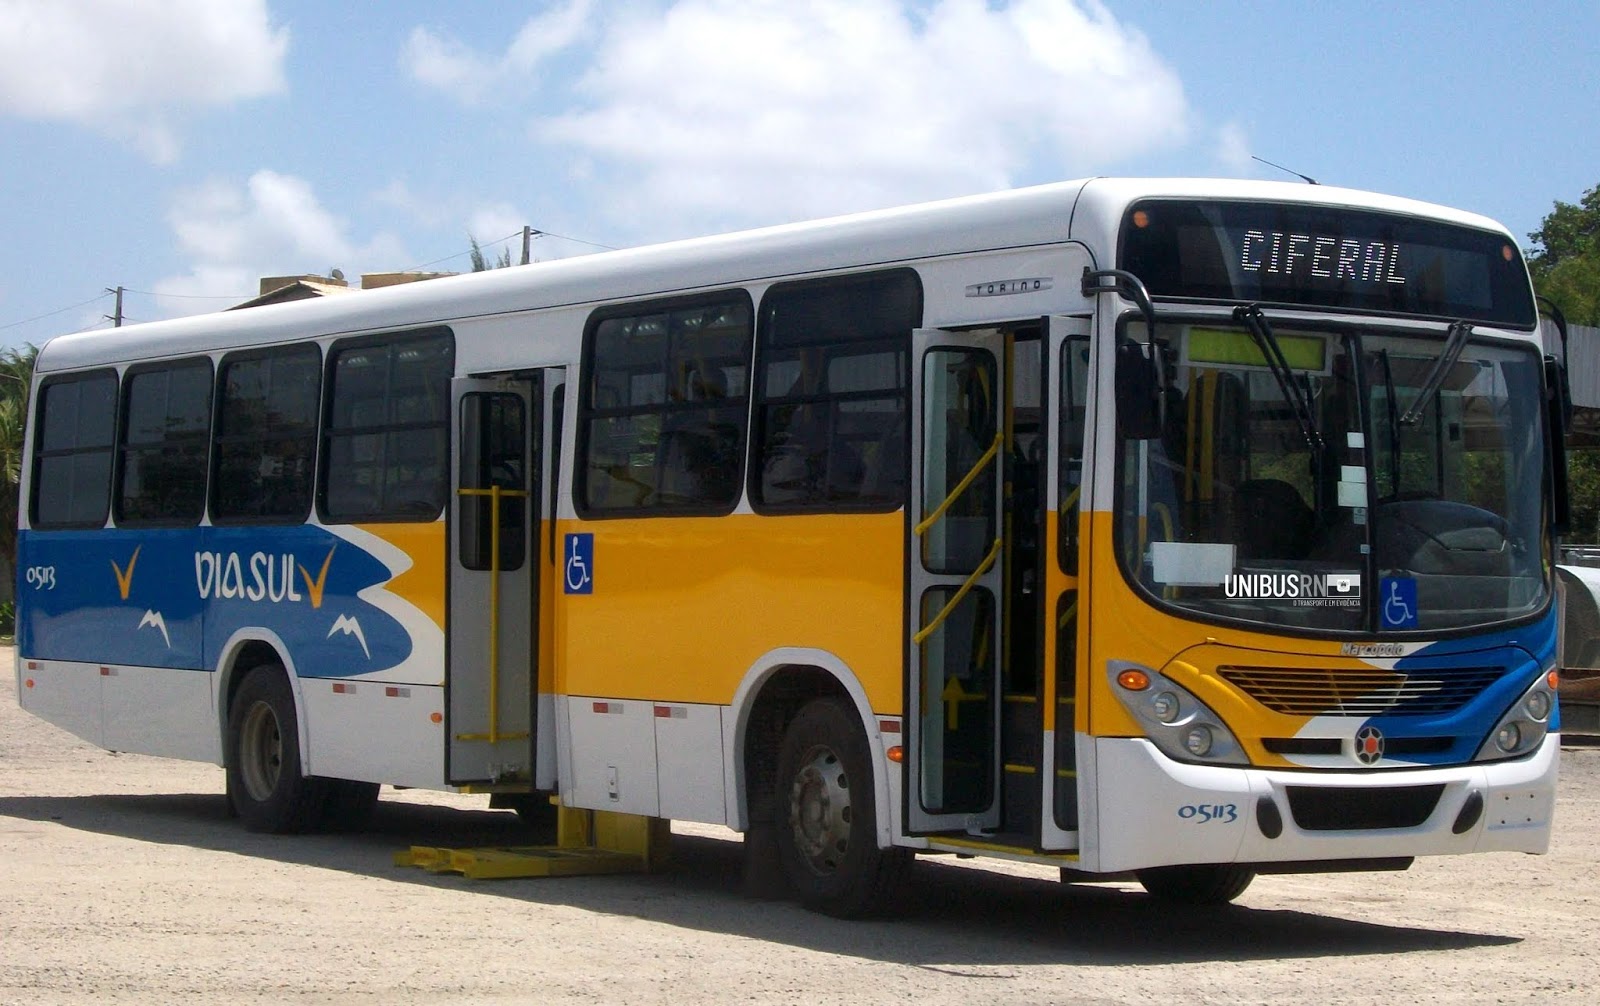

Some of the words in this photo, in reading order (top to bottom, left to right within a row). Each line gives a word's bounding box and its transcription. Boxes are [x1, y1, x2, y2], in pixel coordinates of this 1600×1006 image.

[1241, 230, 1406, 284] CIFERAL
[976, 280, 1041, 295] TORINO
[26, 566, 56, 590] 05113
[1341, 642, 1405, 657] Marcopolo
[1177, 804, 1238, 825] 05113
